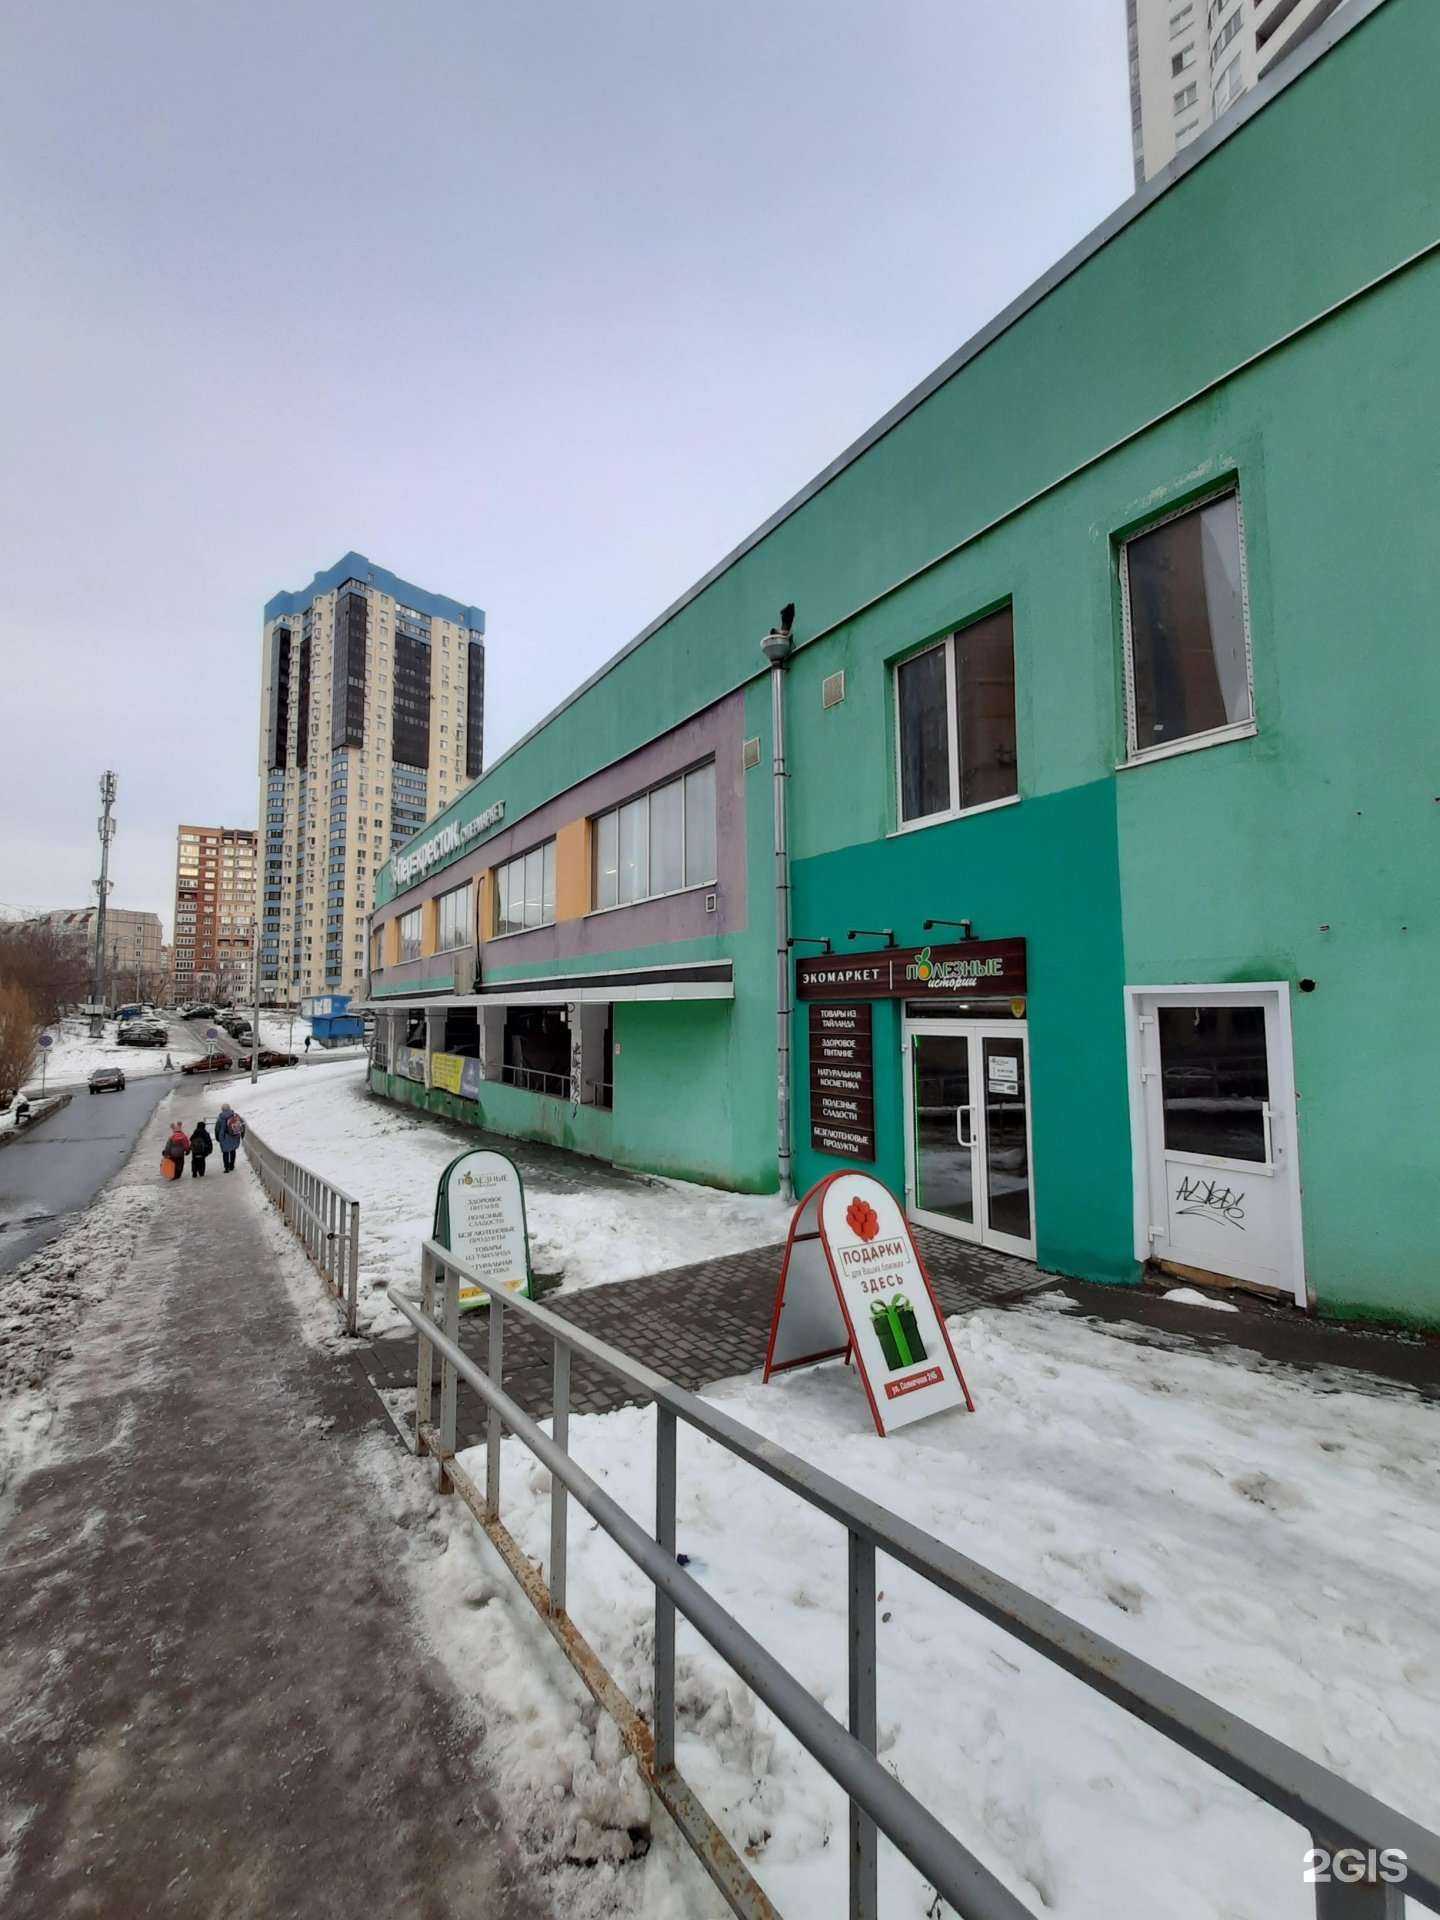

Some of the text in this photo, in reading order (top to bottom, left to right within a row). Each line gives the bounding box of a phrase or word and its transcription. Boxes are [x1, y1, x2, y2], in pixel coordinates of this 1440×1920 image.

[905, 954, 1004, 981] ПОЛЕЗНЫЕ
[803, 968, 880, 984] ЭКОМАРКЕТ
[927, 977, 978, 991] истории
[821, 1009, 846, 1018] ТОВАРЫ
[822, 1018, 856, 1028] ТАЙЛАНДА
[821, 1038, 857, 1048] ЗДОРОВОЕ
[823, 1048, 854, 1058] ПИТАНИЕ
[817, 1067, 862, 1079] НАТУРАЛЬНАЯ
[820, 1078, 860, 1089] КОСМЕТИКА
[822, 1098, 858, 1110] ПОЛЕЗНЫЕ
[822, 1108, 858, 1121] СЛАДОСТИ
[813, 1126, 869, 1145] БЕЗГЛЮТЕНОВЫЕ
[823, 1138, 859, 1153] ПРОДУКТЫ
[842, 1242, 903, 1265] ПОДАРКИ
[860, 1273, 903, 1294] ЗДЕСЬ
